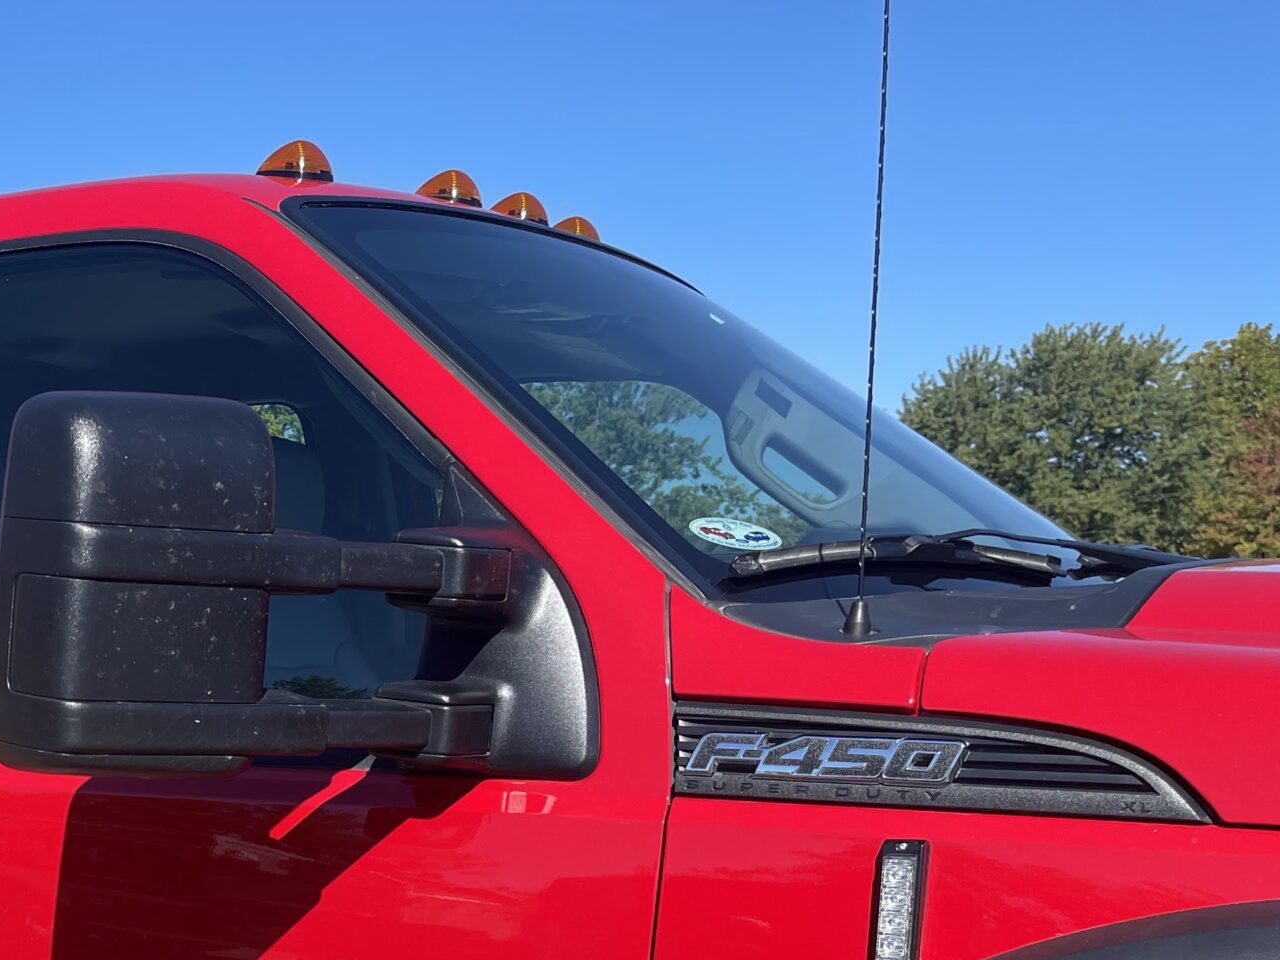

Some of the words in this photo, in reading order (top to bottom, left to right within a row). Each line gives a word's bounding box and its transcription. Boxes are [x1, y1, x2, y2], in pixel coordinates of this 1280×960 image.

[681, 732, 970, 785] F-450
[684, 779, 811, 796] SUPER
[834, 786, 942, 801] DUTY
[1120, 801, 1153, 813] XL
